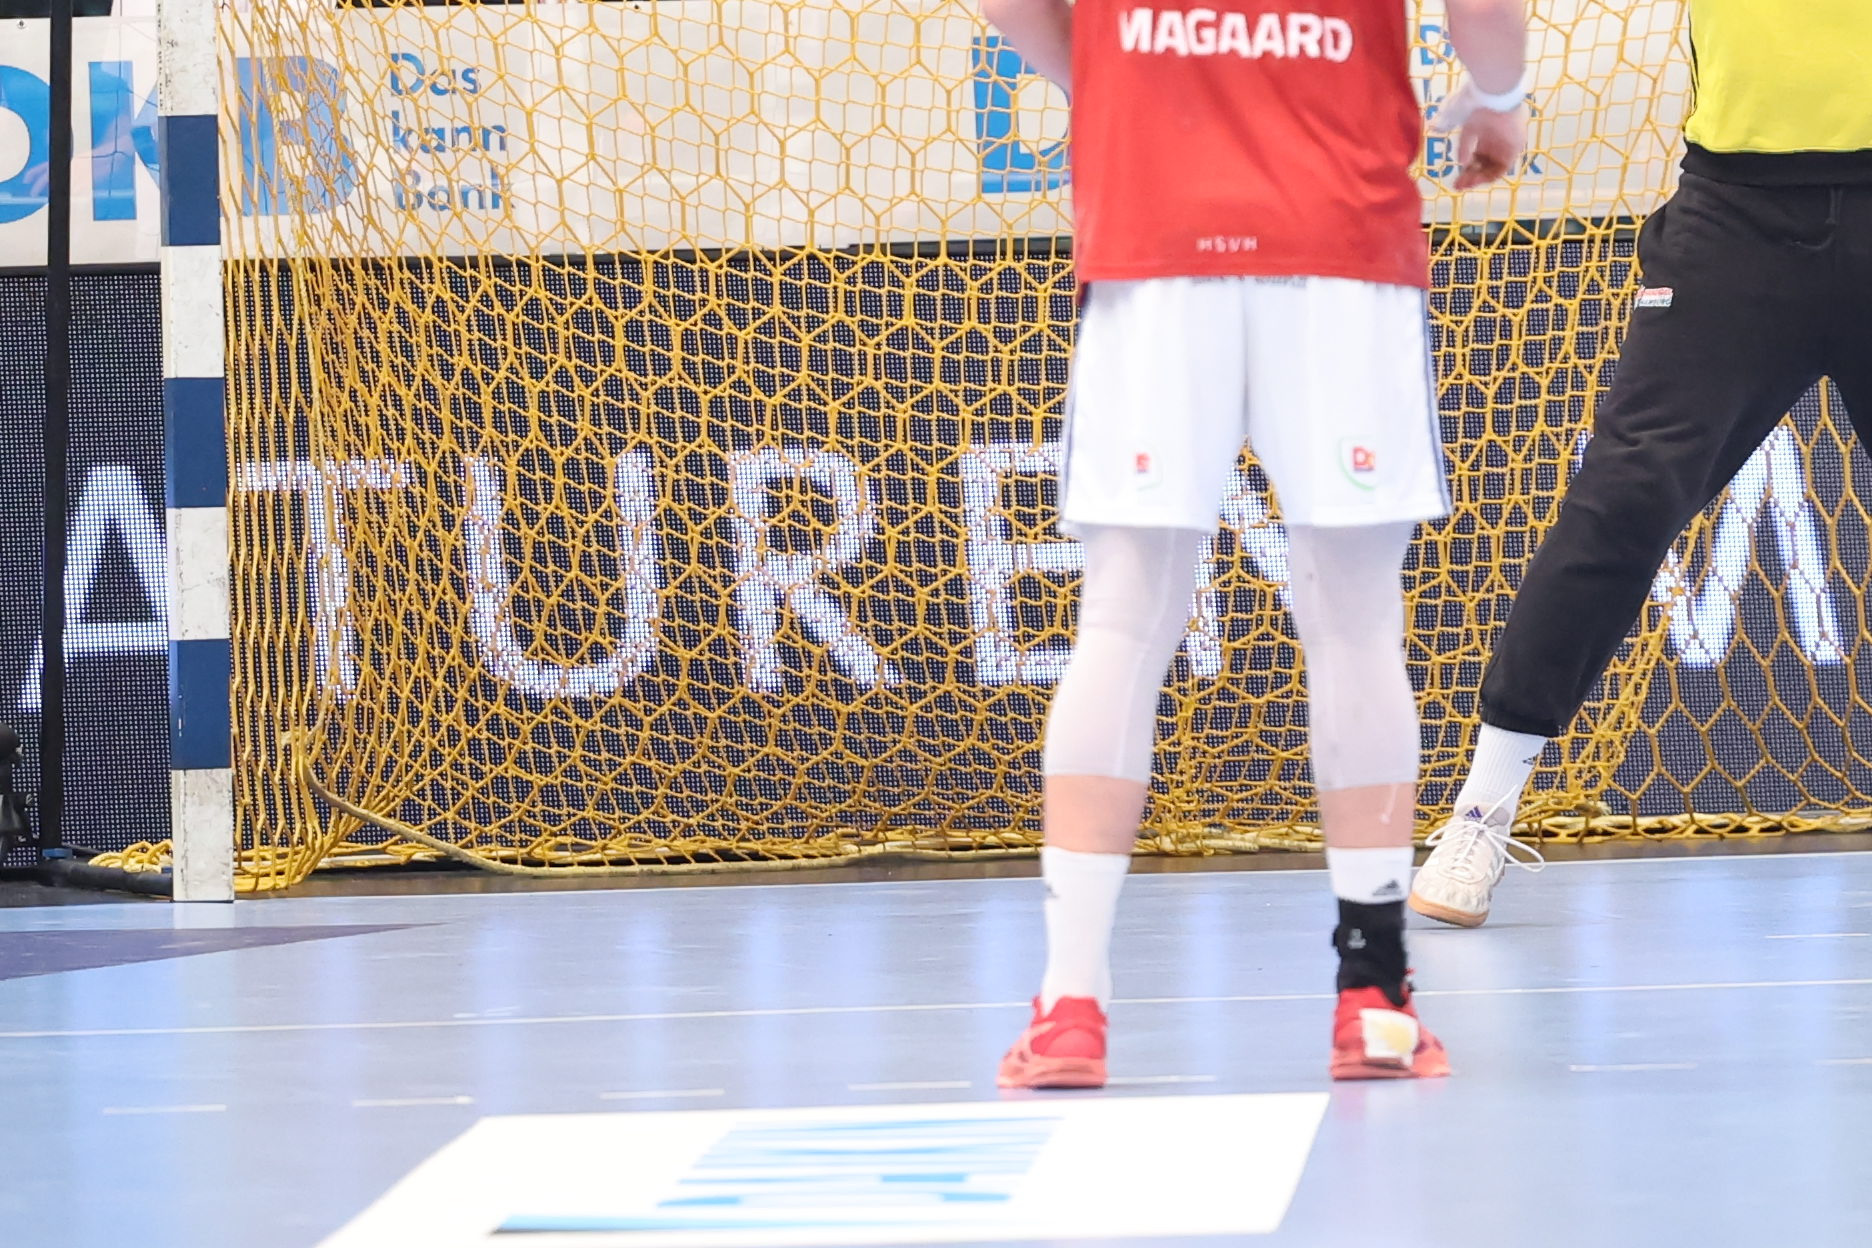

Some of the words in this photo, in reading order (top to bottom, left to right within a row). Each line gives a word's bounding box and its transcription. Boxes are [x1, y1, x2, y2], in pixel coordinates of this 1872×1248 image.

[390, 52, 481, 97] Das
[393, 110, 508, 153] kann
[395, 168, 513, 212] Bank
